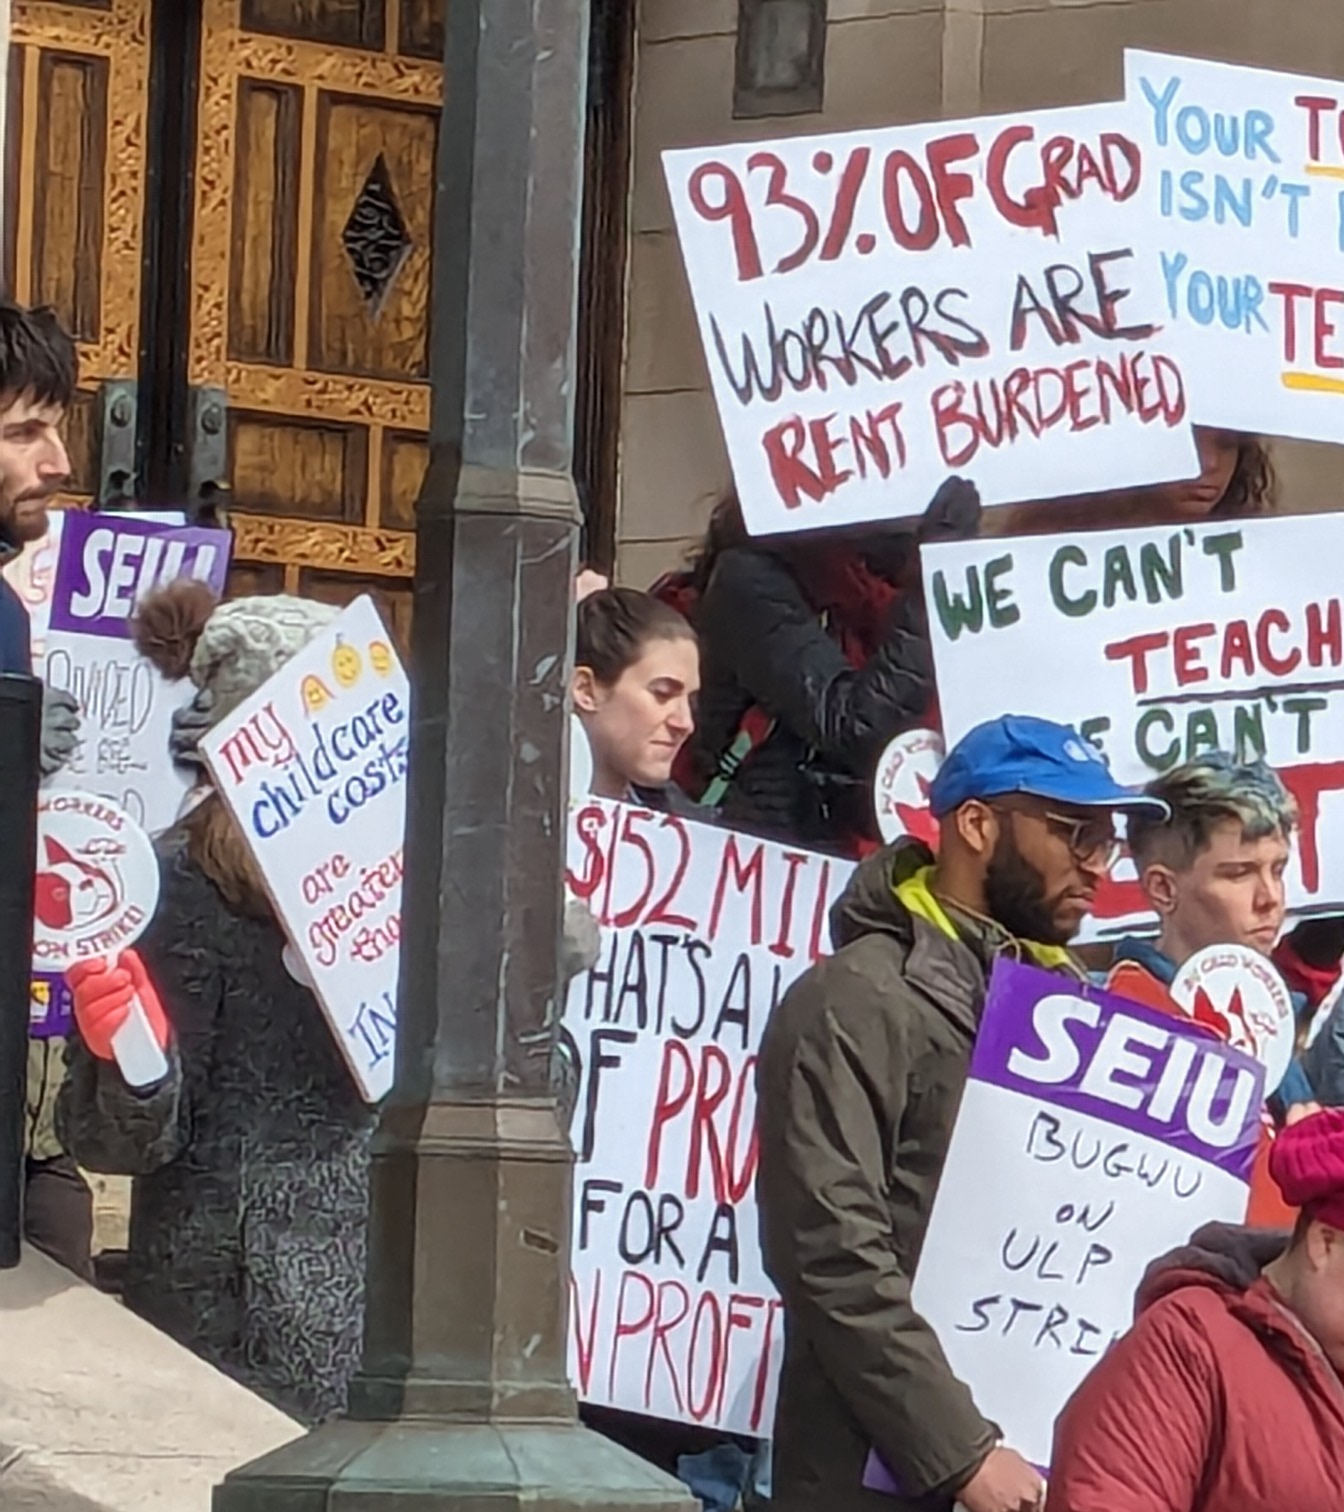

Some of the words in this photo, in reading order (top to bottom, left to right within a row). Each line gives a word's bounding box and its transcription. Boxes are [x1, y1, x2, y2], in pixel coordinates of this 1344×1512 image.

[1139, 75, 1281, 164] YOUR
[986, 125, 1142, 242] GRAD
[1160, 170, 1310, 238] ISN'T
[709, 286, 989, 406] WORKERS
[1009, 247, 1163, 351] ARE
[1159, 251, 1270, 335] YOUR
[762, 401, 907, 510] RENT
[930, 351, 1186, 467] BURDENED
[932, 554, 1021, 642] WE
[1048, 528, 1244, 618] CAN'T
[1104, 597, 1344, 694] TEACH
[218, 700, 297, 785] my
[250, 692, 405, 839] childcare
[301, 853, 352, 904] are
[565, 806, 697, 928] $152
[1006, 993, 1256, 1148] SEIU
[1026, 1111, 1203, 1198] BUGWU
[578, 1179, 685, 1270] FOR
[698, 1203, 741, 1284] A
[1002, 1228, 1113, 1285] ULP
[1055, 1201, 1115, 1232] ON
[955, 1295, 1118, 1356] STRI
